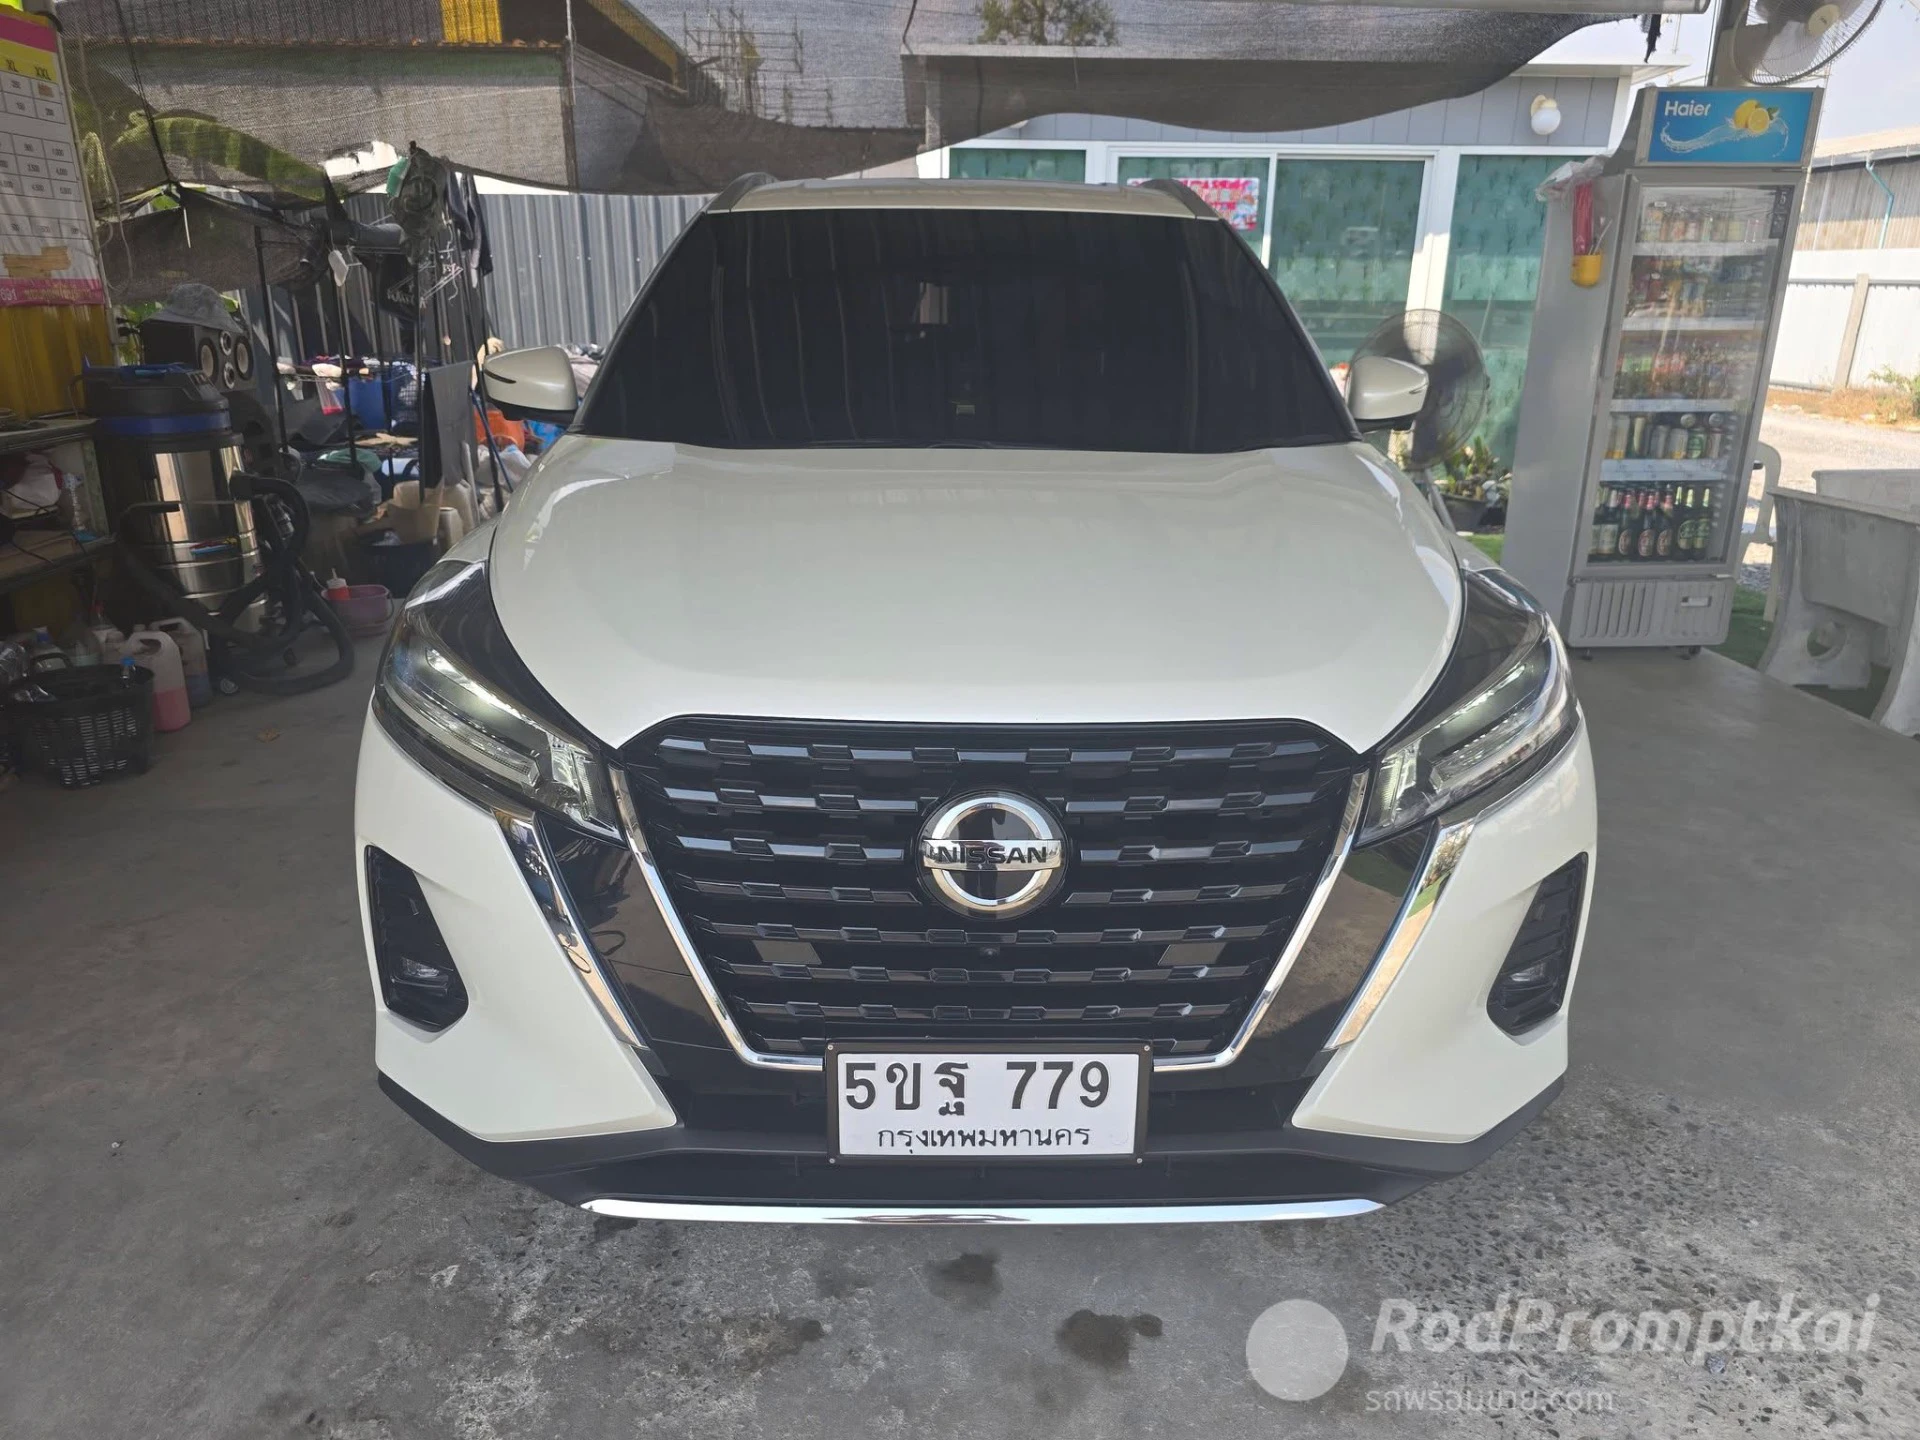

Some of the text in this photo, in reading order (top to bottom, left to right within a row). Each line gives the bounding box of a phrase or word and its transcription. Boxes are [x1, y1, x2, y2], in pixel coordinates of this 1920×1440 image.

[5, 58, 19, 73] XL
[1664, 99, 1711, 117] Haier
[936, 846, 1047, 864] NISSAN
[1006, 1061, 1110, 1110] 779
[878, 1128, 1091, 1155] กรุงเทพมหานคร
